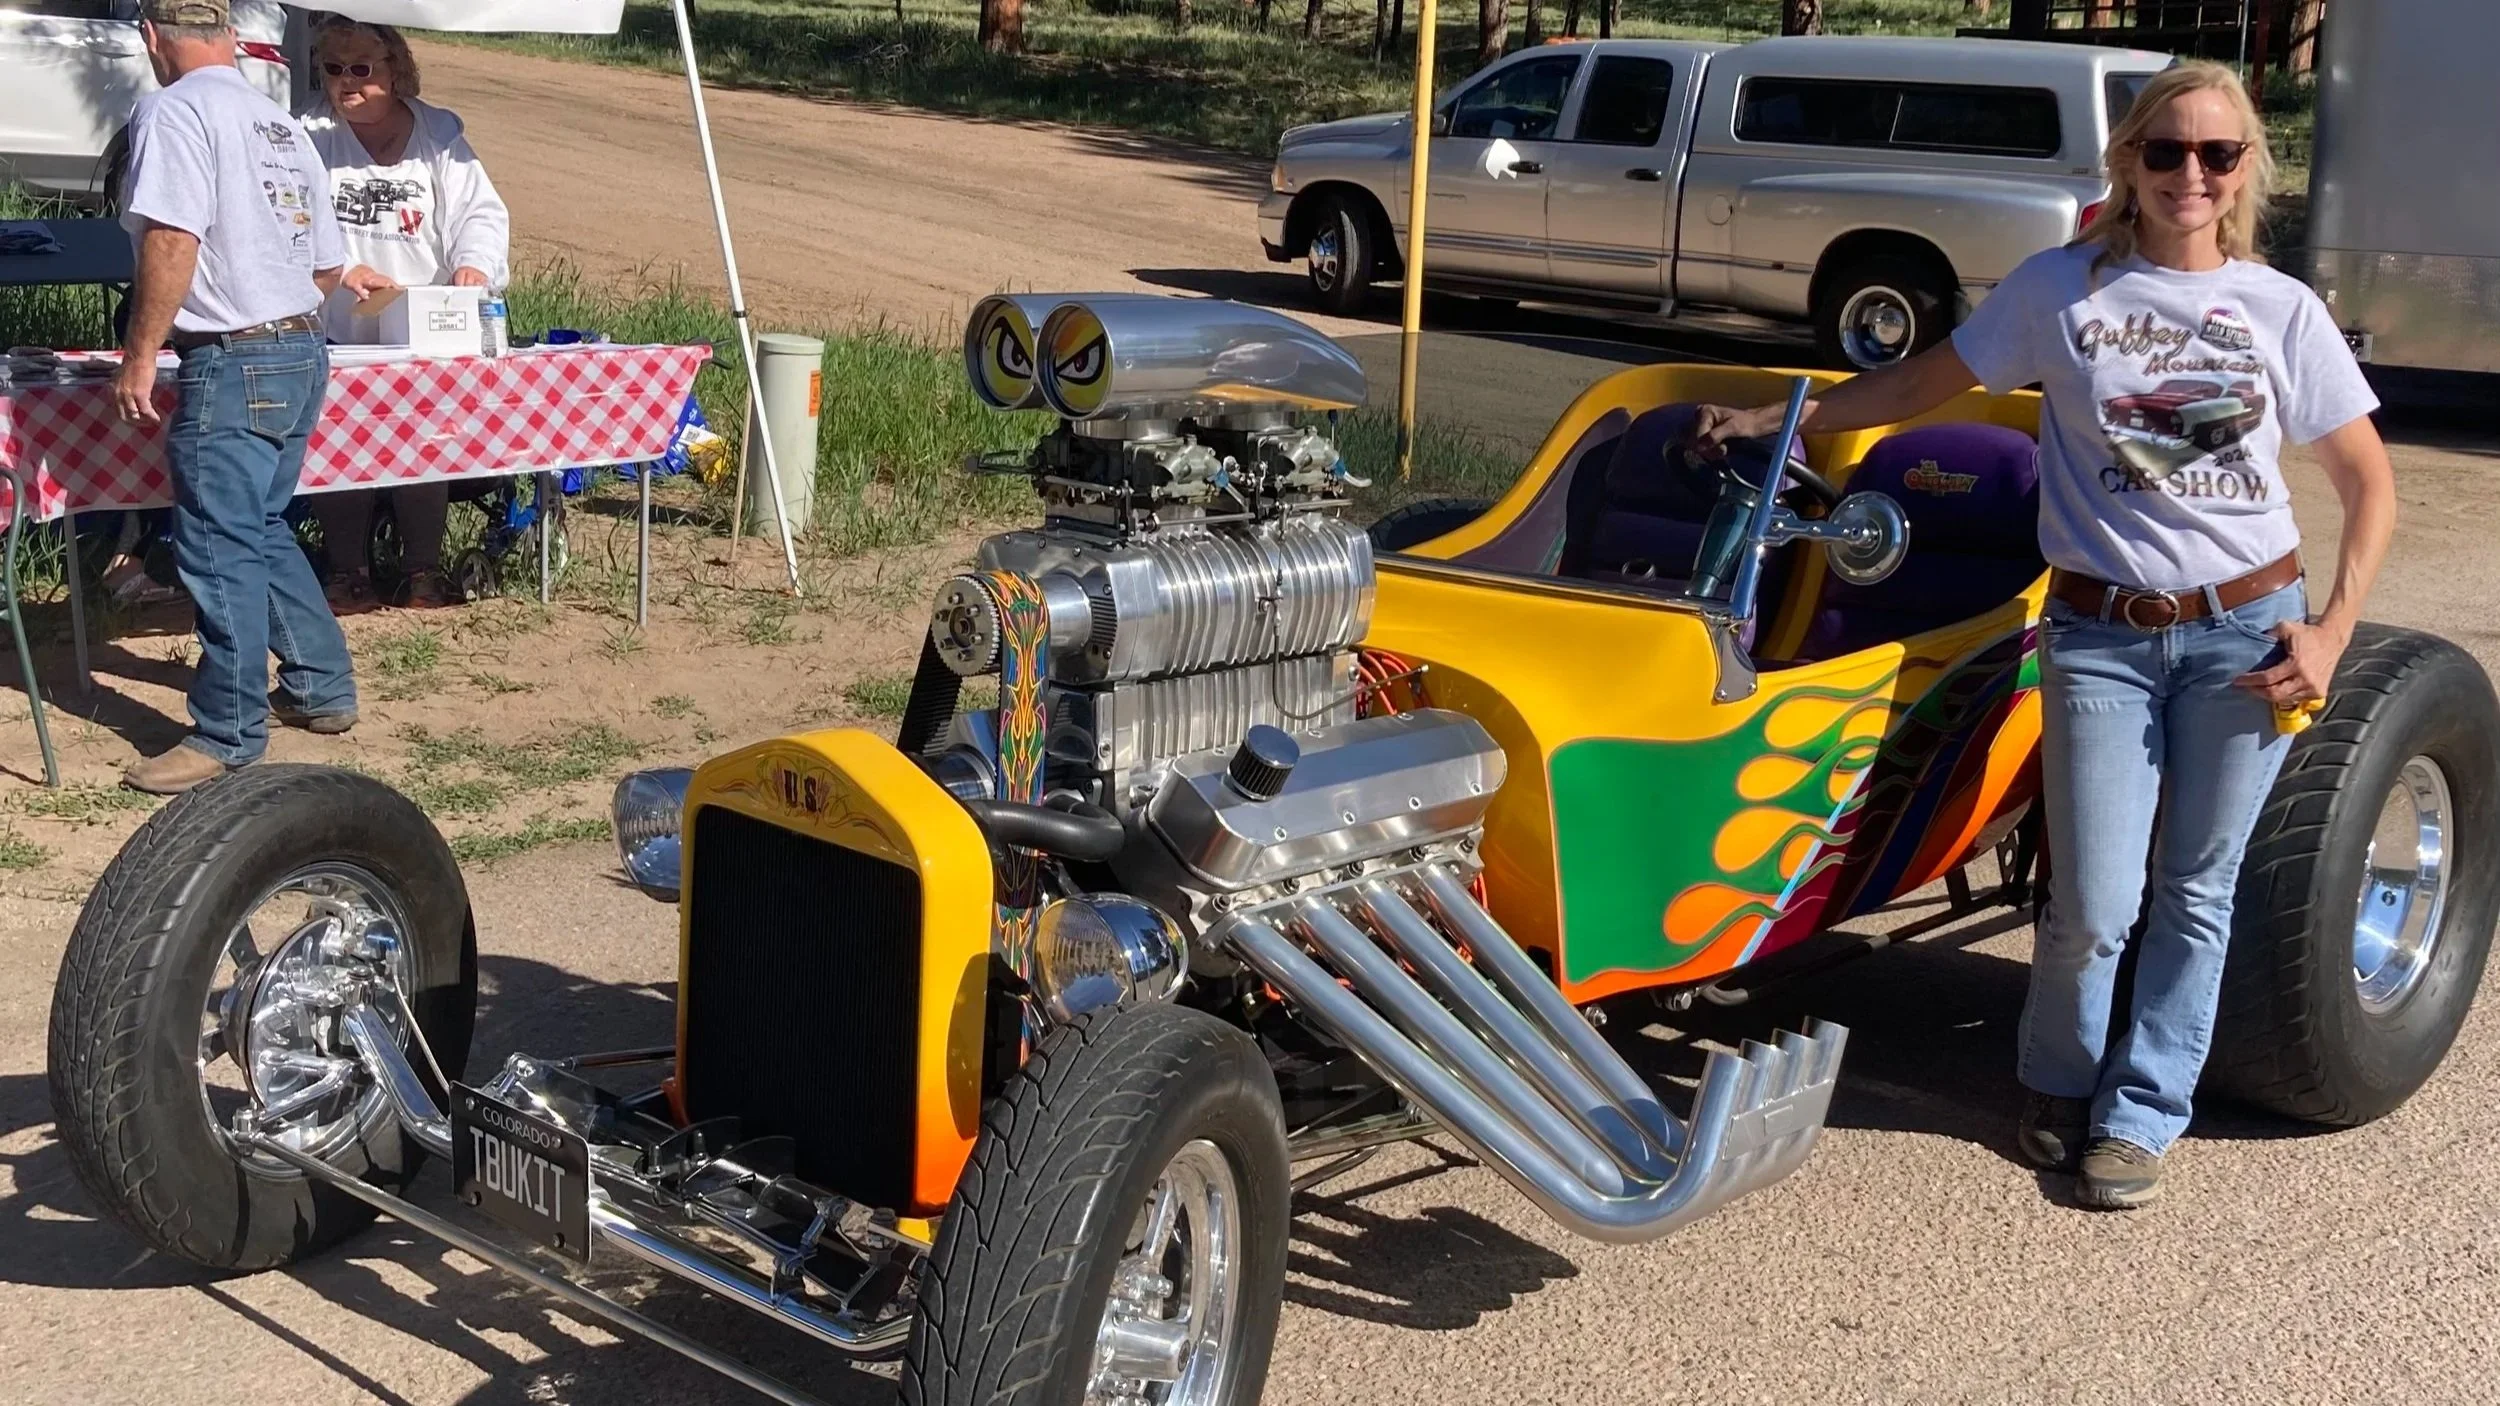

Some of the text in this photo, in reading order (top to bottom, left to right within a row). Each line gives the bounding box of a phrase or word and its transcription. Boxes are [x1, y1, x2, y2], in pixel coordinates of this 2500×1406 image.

[2076, 312, 2193, 361] Guffey
[2167, 470, 2268, 503] SHOW
[482, 1105, 550, 1149] COLORADO
[469, 1126, 566, 1223] TBUKIT
